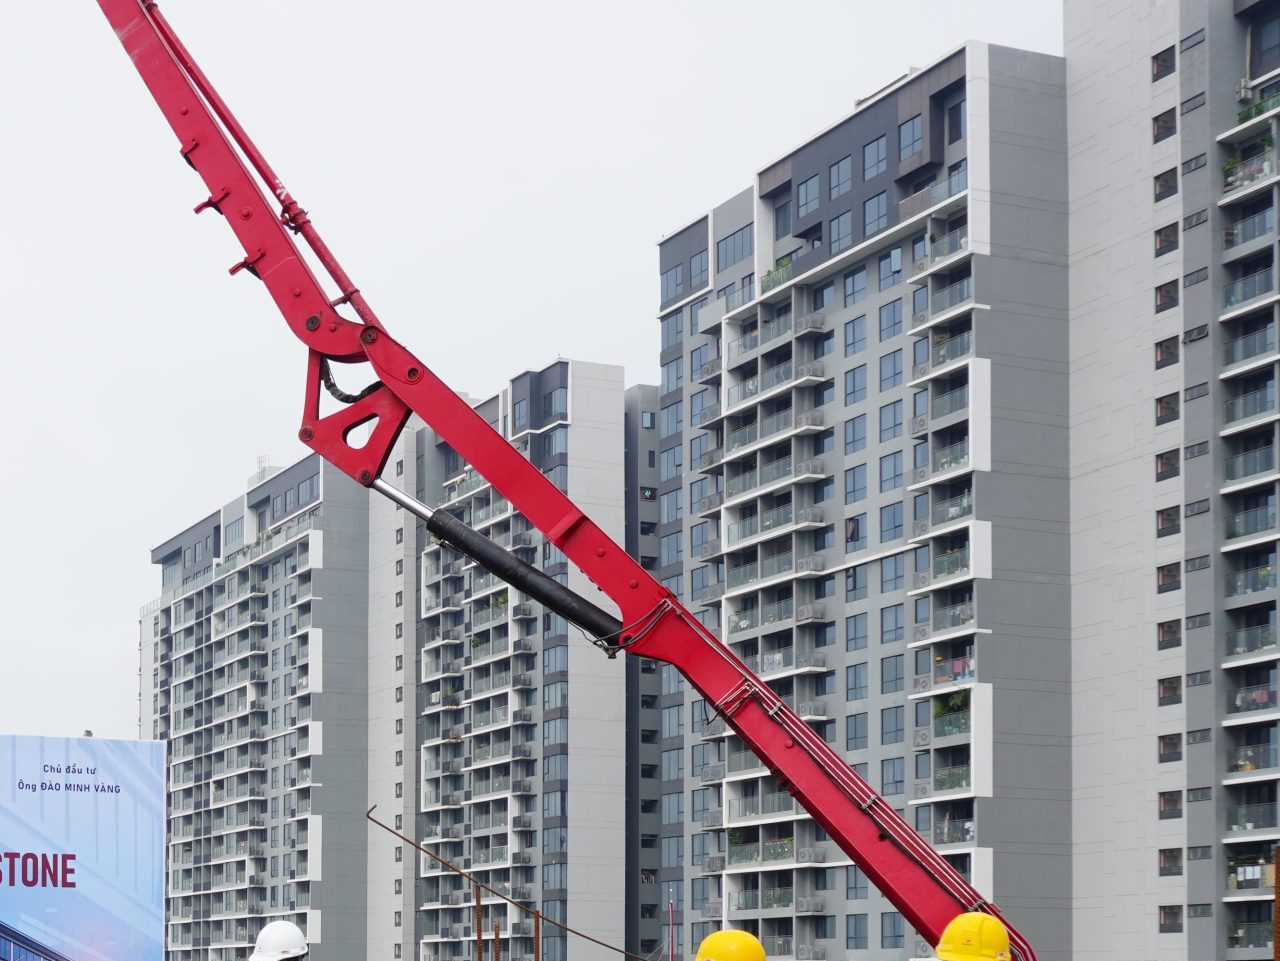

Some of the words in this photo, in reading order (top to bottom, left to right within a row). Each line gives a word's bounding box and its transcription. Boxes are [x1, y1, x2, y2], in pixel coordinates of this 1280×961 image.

[43, 763, 62, 774] Chủ
[65, 763, 83, 775] đầu
[86, 766, 97, 775] tư
[18, 778, 37, 793] Ông
[40, 779, 61, 792] ĐÀO
[64, 783, 91, 793] MINH
[93, 782, 121, 794] VÀNG
